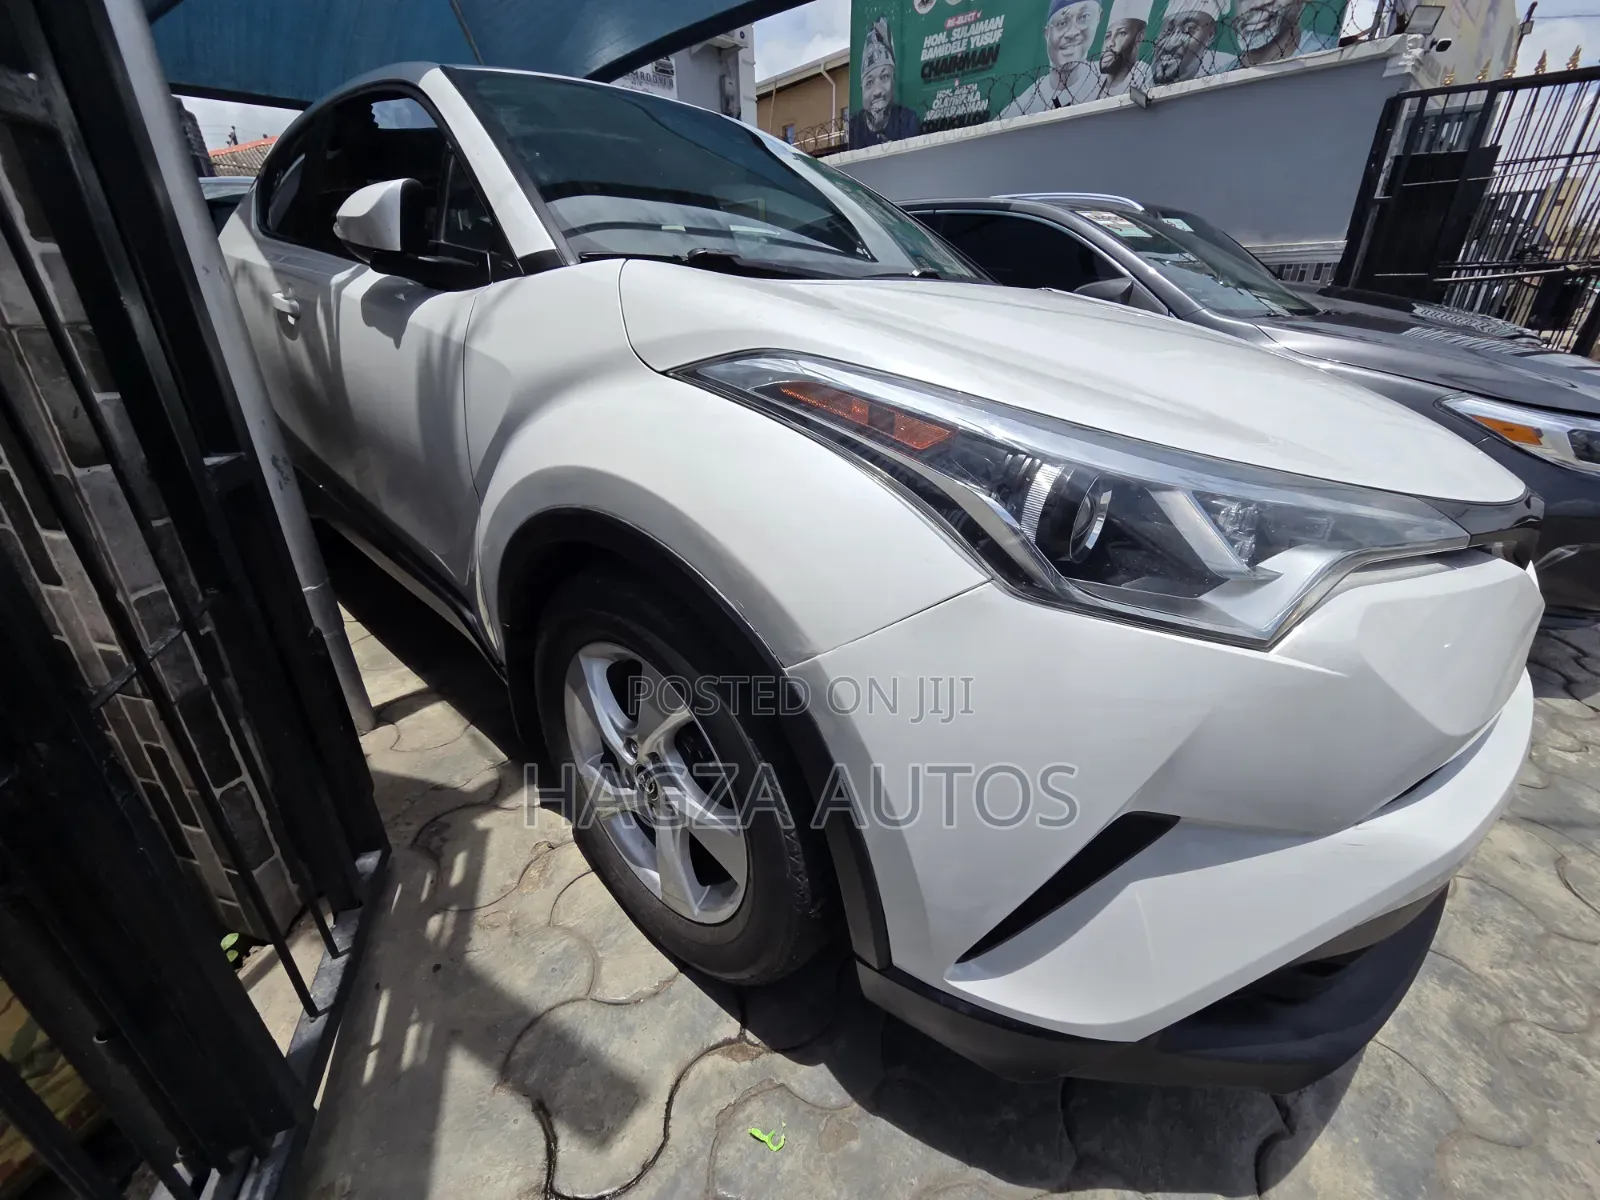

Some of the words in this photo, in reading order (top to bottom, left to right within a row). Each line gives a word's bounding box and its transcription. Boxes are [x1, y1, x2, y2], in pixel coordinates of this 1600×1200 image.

[923, 31, 949, 48] HON.
[951, 14, 1005, 41] SULAIMAN
[946, 12, 977, 28] RE-ELECT
[921, 38, 968, 61] BAMIDELE
[970, 28, 1004, 49] YUSUF
[921, 44, 1000, 79] CHAIRMAN
